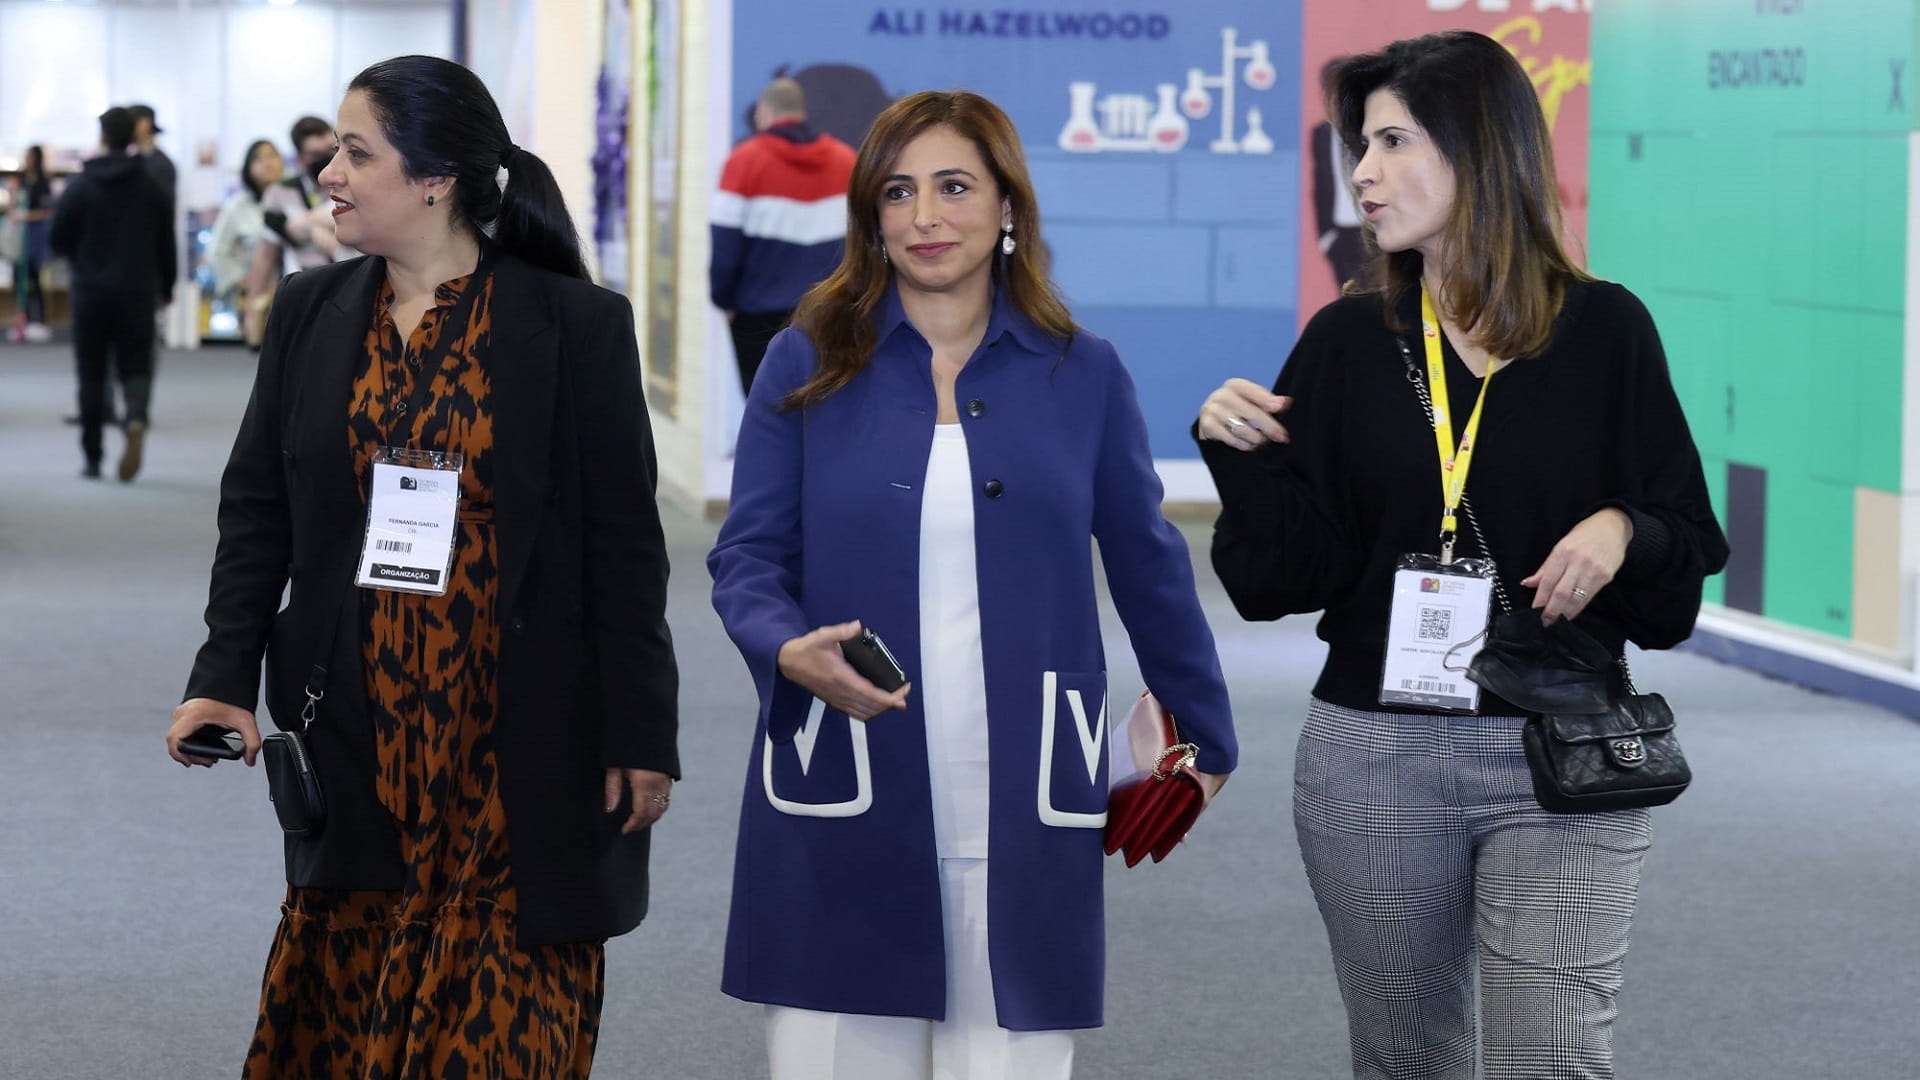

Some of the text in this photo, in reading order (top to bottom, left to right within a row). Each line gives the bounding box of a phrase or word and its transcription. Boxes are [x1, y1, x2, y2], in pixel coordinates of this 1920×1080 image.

[869, 9, 1171, 40] ALI HAZELWOOD
[1707, 47, 1806, 89] ENCANTADO
[388, 518, 439, 529] FERNANDA GARCIA
[380, 568, 430, 580] ORGANIZAÇÃO
